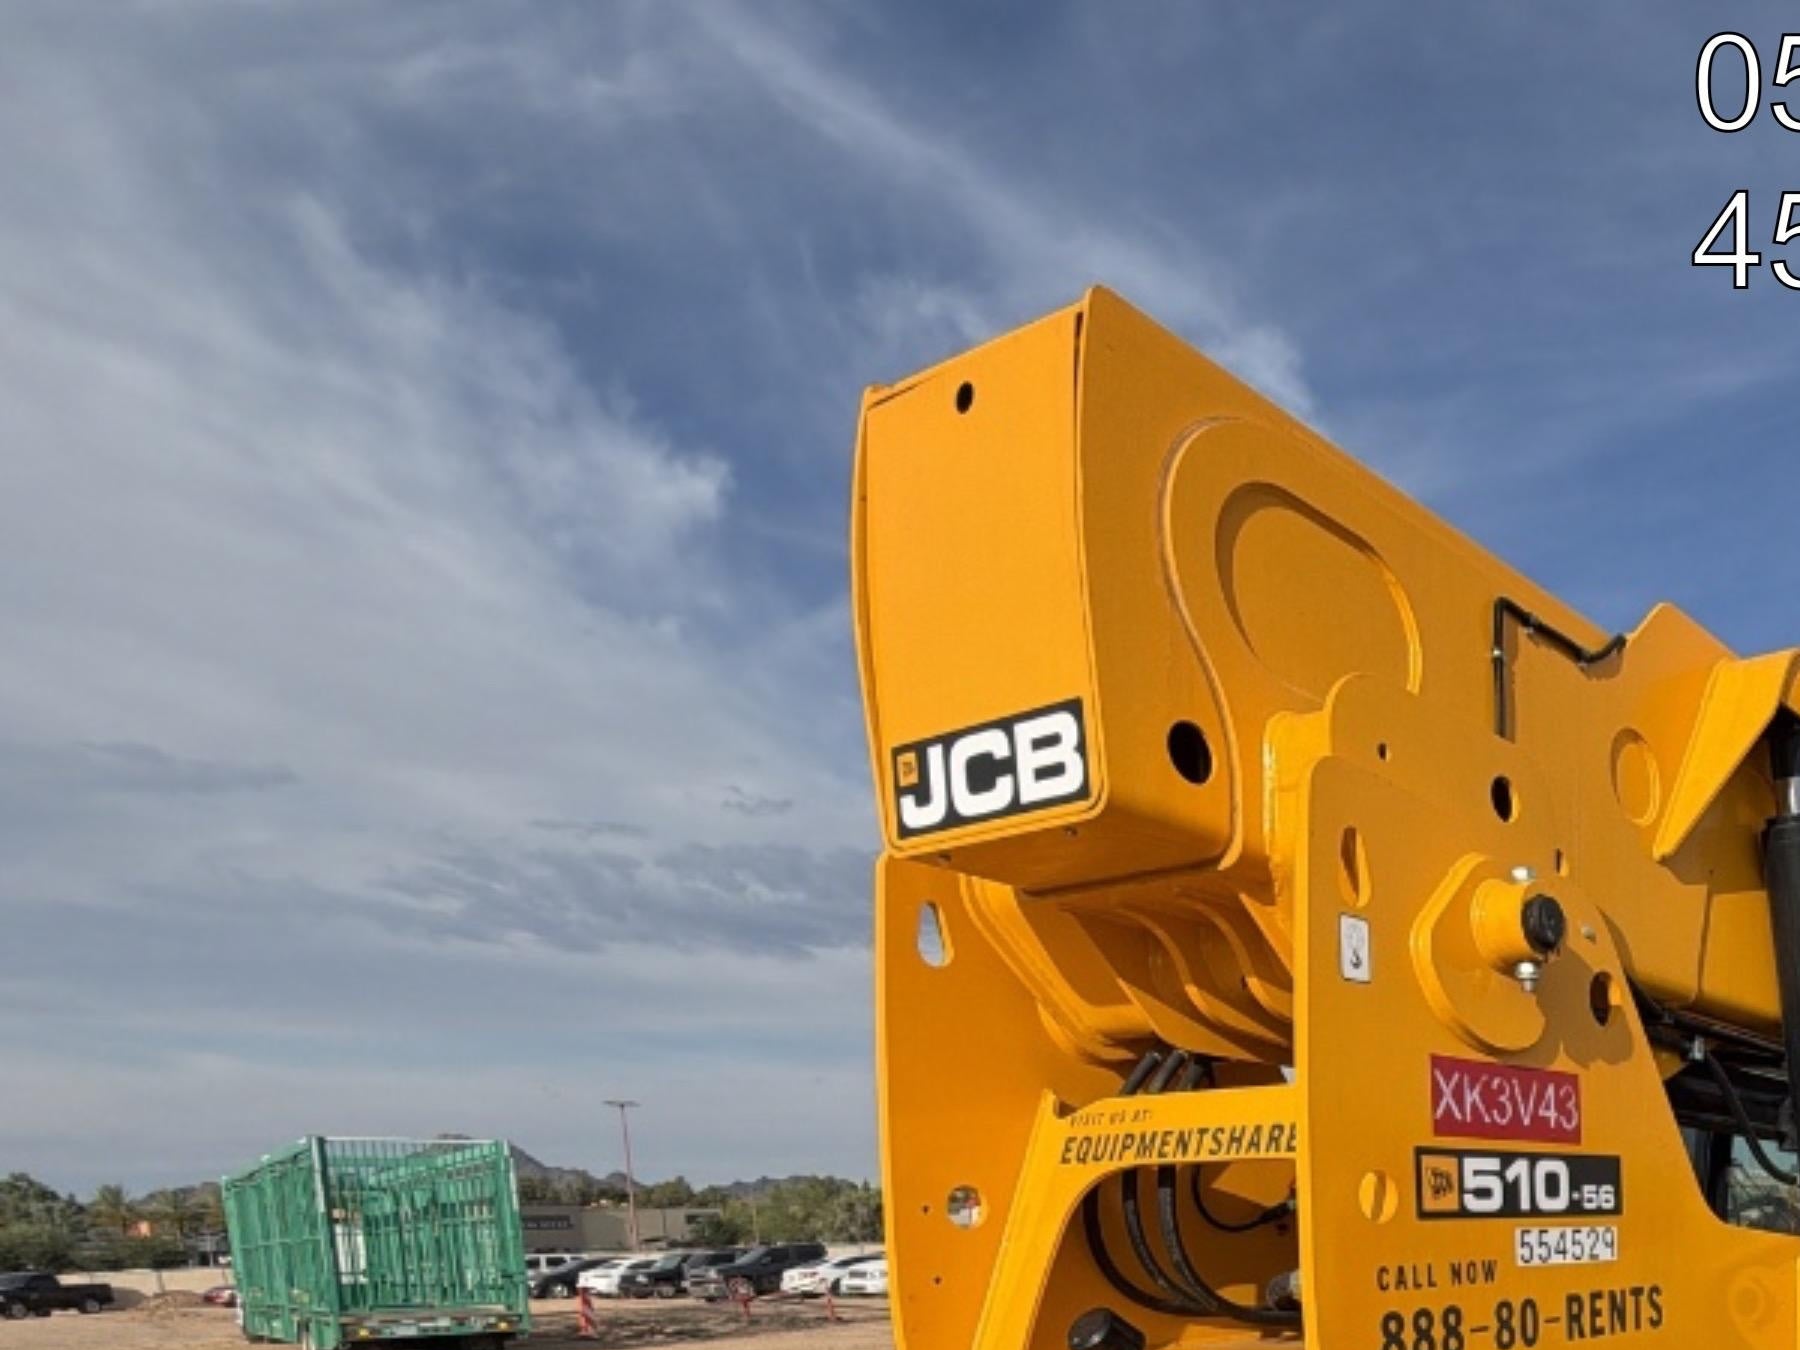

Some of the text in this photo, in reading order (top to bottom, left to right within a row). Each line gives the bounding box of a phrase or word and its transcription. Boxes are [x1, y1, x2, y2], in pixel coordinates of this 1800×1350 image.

[900, 710, 1085, 830] JCB
[1433, 1068, 1580, 1131] XK3V43
[1519, 1227, 1615, 1264] 554529
[1376, 1259, 1499, 1292] CALL NOW
